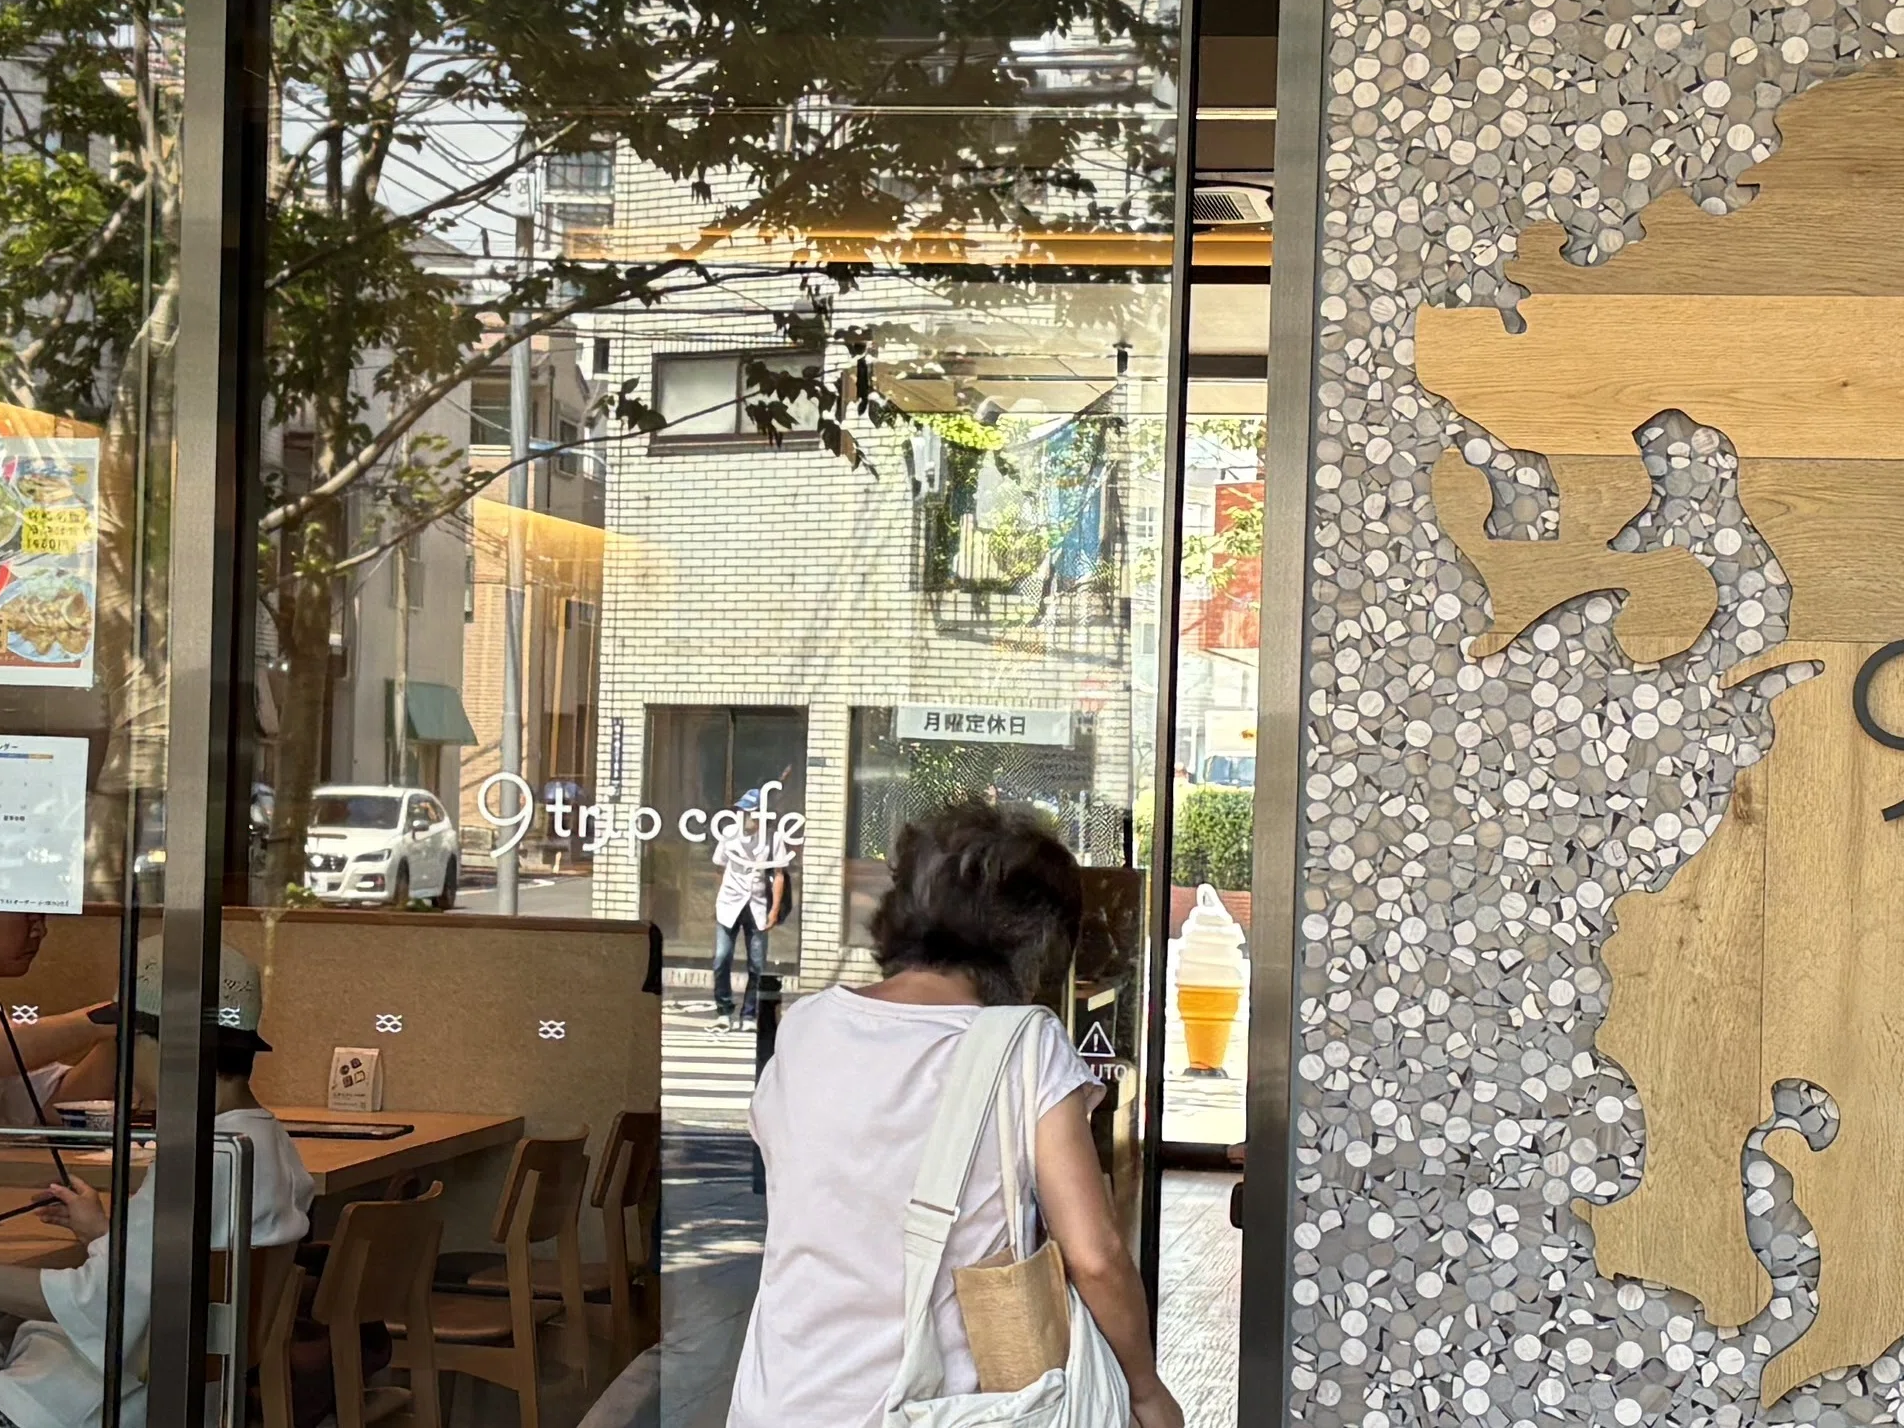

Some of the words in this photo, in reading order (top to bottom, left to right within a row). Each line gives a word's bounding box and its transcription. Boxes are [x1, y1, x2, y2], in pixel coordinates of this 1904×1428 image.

[924, 711, 1027, 736] 月曜定休日
[679, 780, 806, 850] cafe
[1090, 1063, 1127, 1082] UTO
